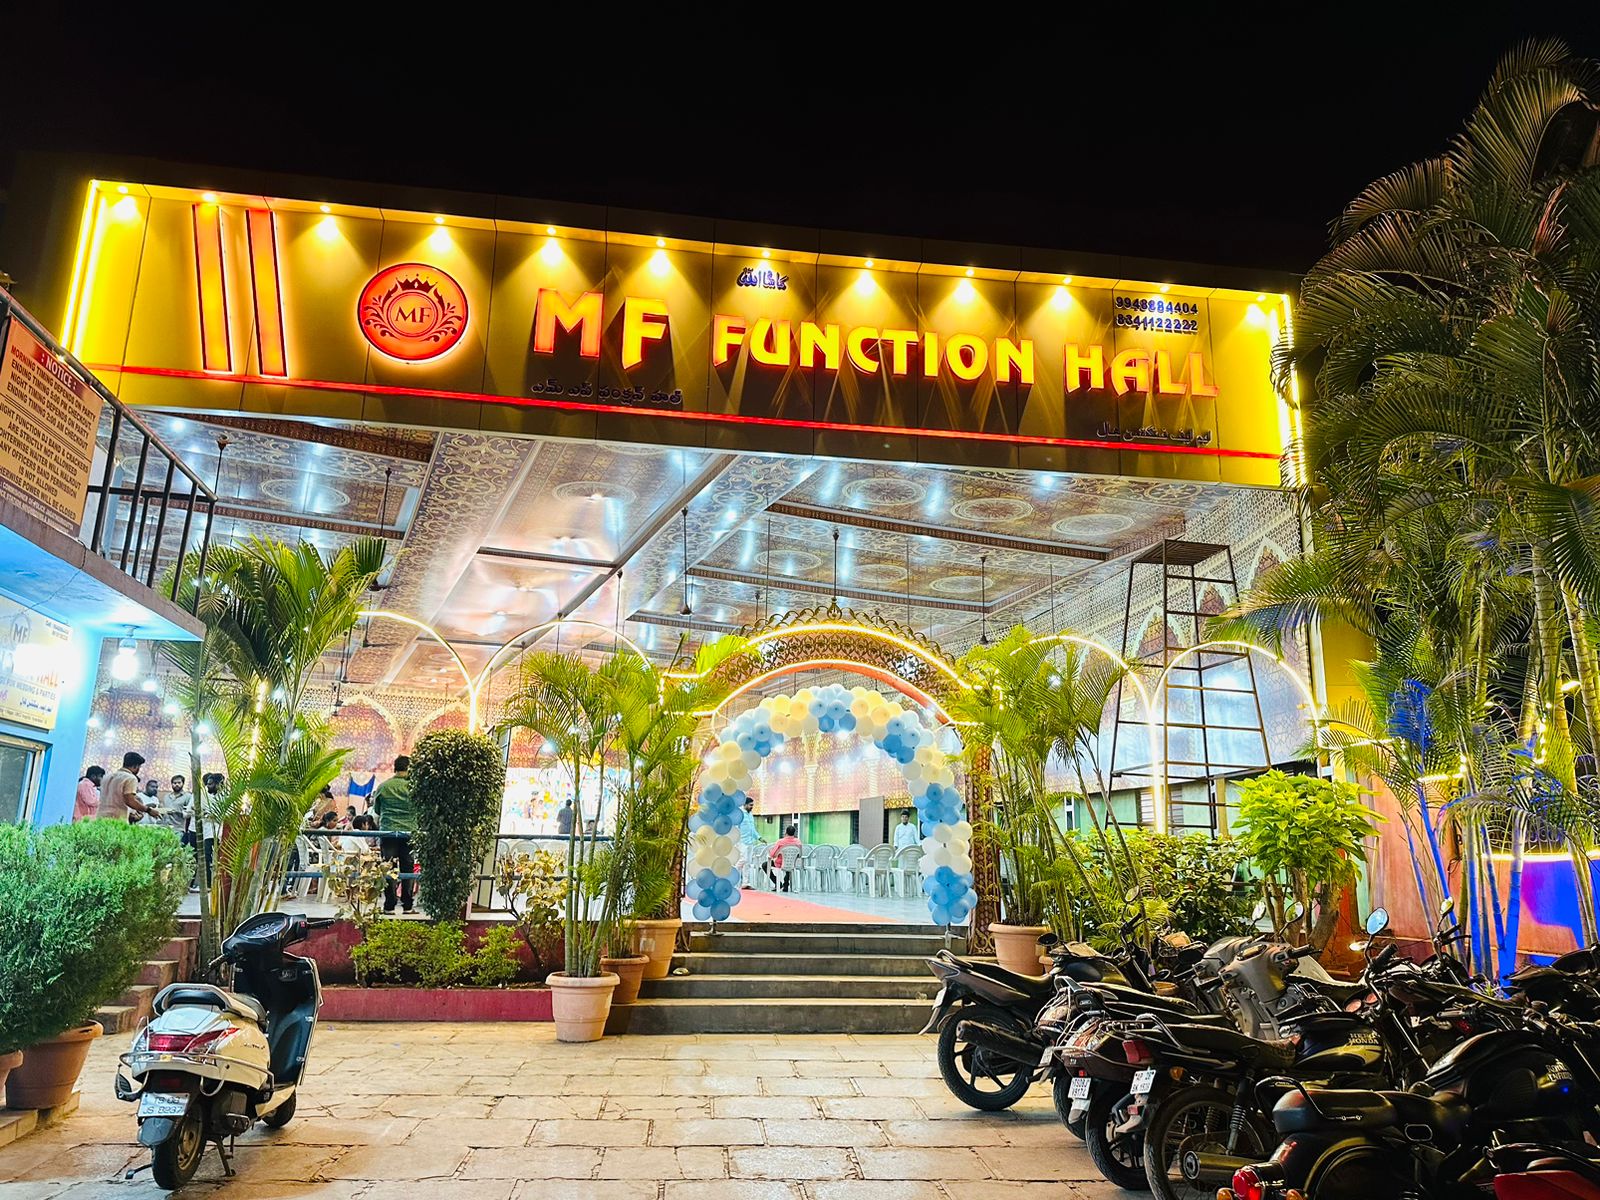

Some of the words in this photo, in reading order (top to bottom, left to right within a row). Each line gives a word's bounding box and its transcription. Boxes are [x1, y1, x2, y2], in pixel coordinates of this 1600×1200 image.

[394, 306, 432, 324] MF
[1116, 297, 1198, 314] 9948884404
[1117, 314, 1198, 332] 8341122222
[45, 356, 72, 387] NOTICE
[713, 314, 1035, 385] FUNCTION
[1063, 343, 1220, 396] HALL
[10, 345, 35, 372] MORNING
[35, 366, 53, 387] TIMING
[53, 381, 74, 404] DEPENDS
[74, 399, 81, 411] ON
[81, 405, 95, 422] PARTY
[11, 358, 31, 382] ENDING
[31, 375, 49, 396] TIMING
[49, 390, 60, 405] 5:00
[6, 381, 27, 404] ENDING
[27, 398, 46, 418] TIMING
[46, 412, 56, 426] 2:00
[56, 420, 64, 432] AM
[64, 426, 88, 450] CHECKOUT
[27, 384, 45, 406] TIMING
[46, 400, 67, 423] DEPENDS
[67, 416, 74, 428] ON
[74, 422, 88, 440] PARTY
[7, 420, 19, 435] ARE
[19, 429, 42, 452] STRICTLY
[43, 446, 53, 460] NOT
[14, 413, 41, 438] FUNCTION
[41, 433, 47, 444] DJ
[48, 438, 61, 454] BAND
[11, 448, 36, 471] OFFICERS
[36, 465, 50, 480] BAND
[18, 465, 24, 475] IS
[24, 469, 35, 482] NOT
[35, 476, 57, 497] ALLOWED
[29, 448, 48, 467] WAITER
[59, 469, 81, 490] WALKOUT
[22, 480, 40, 498] POWER
[52, 498, 58, 509] BE
[58, 502, 76, 520] CLOSED
